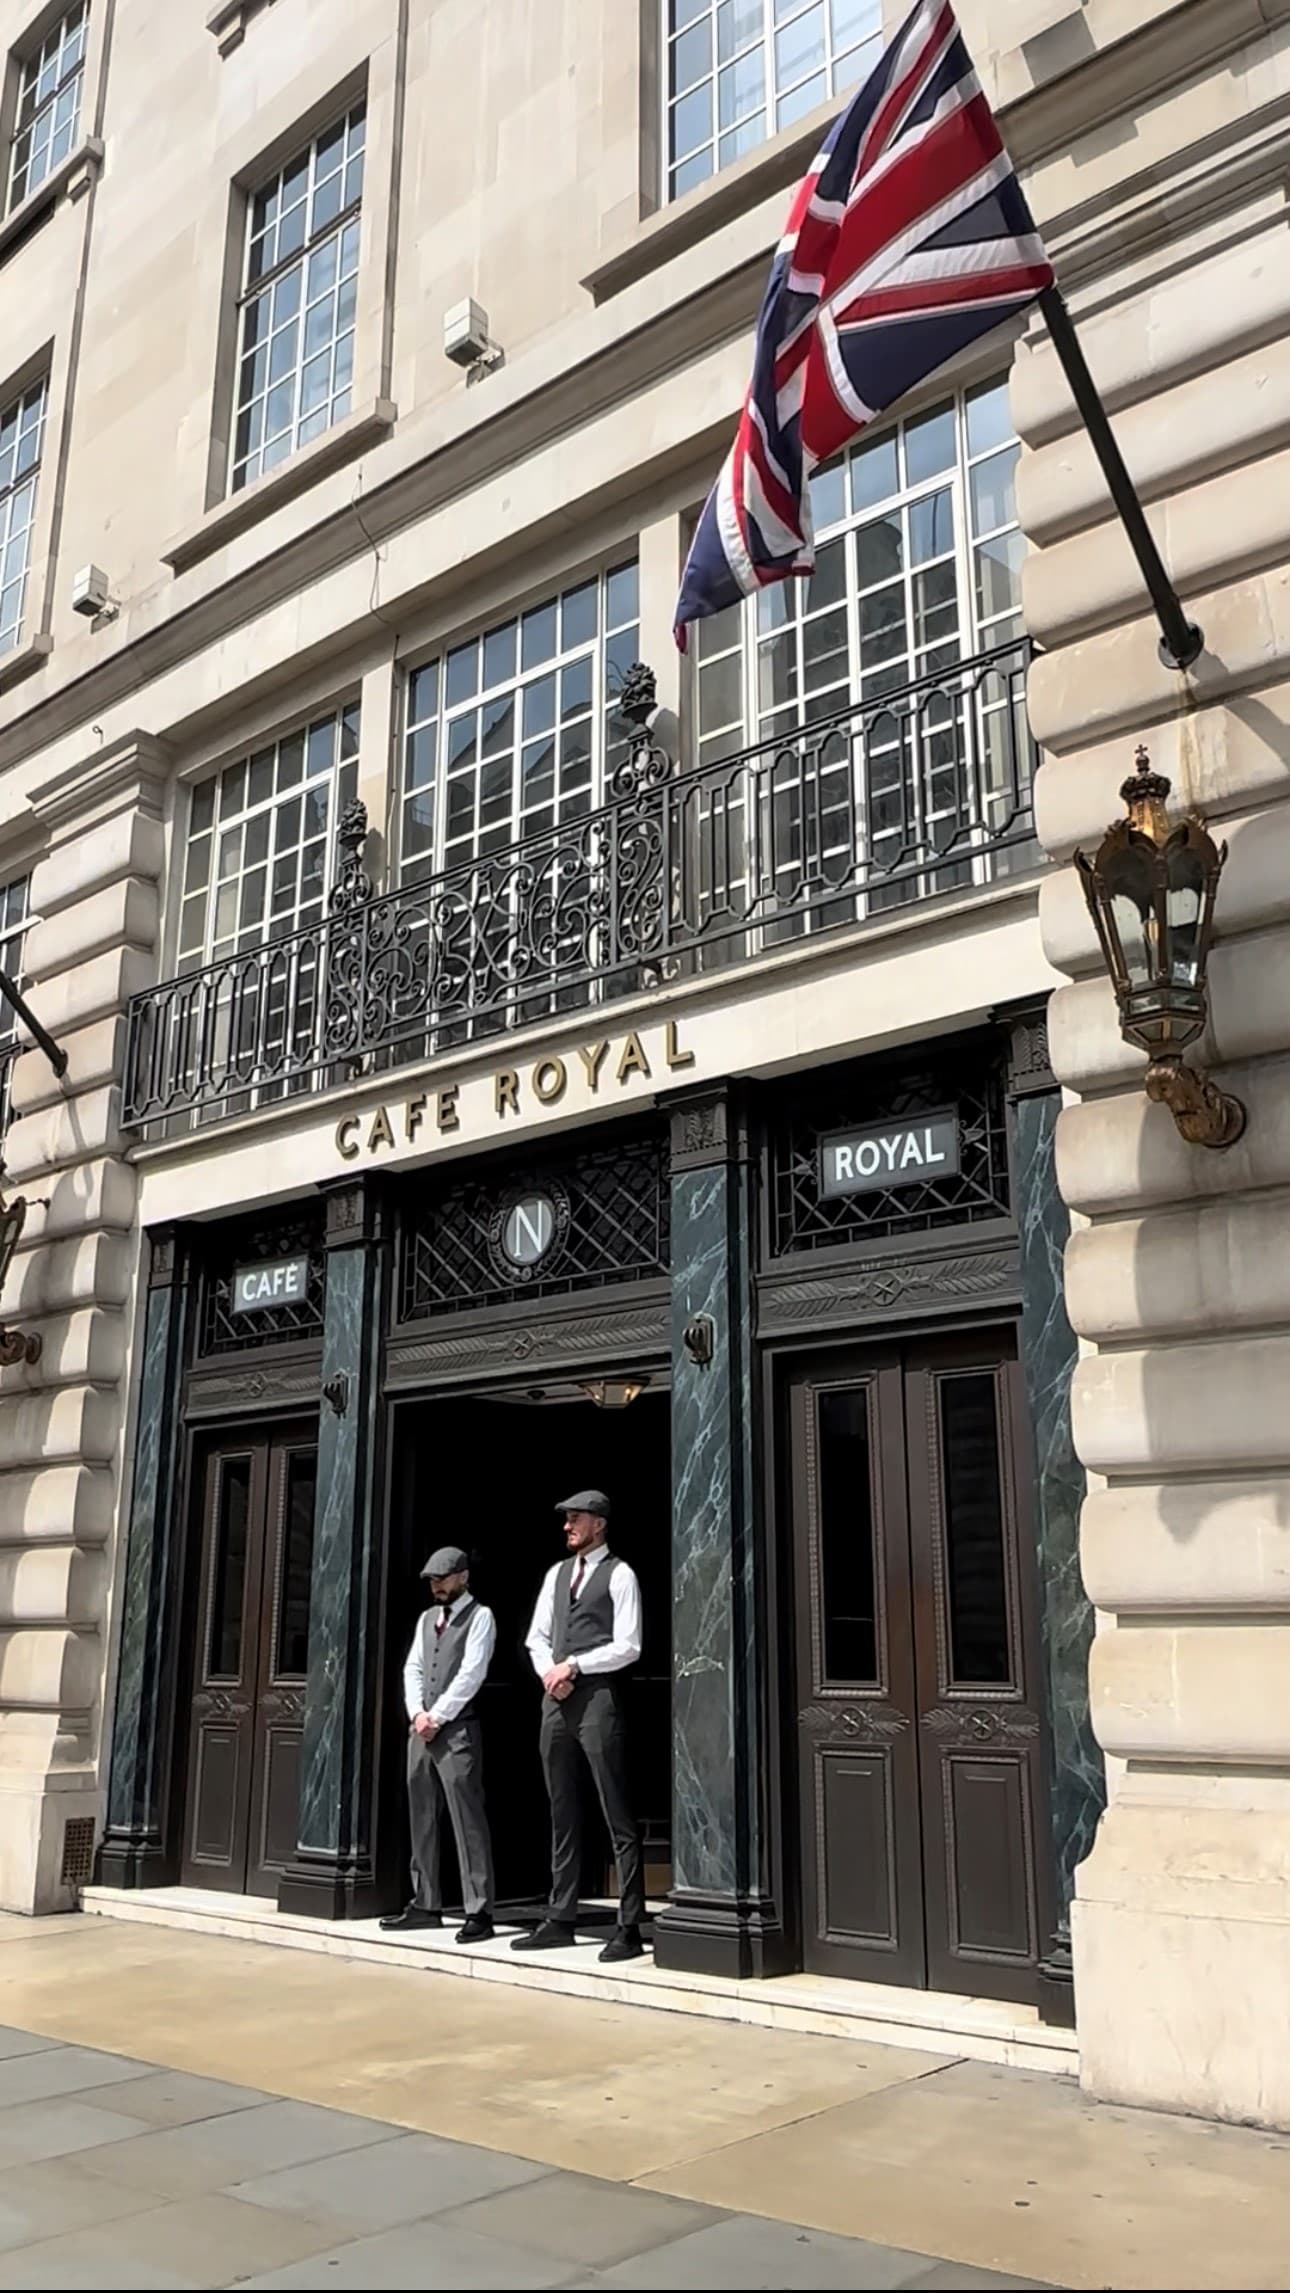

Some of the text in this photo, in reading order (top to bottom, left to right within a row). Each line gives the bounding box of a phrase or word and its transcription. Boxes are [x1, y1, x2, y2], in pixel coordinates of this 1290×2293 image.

[335, 1021, 694, 1159] CAFE ROYAL
[835, 1128, 945, 1180] ROYAL
[514, 1201, 543, 1257] N
[242, 1263, 298, 1301] CAFÉ
